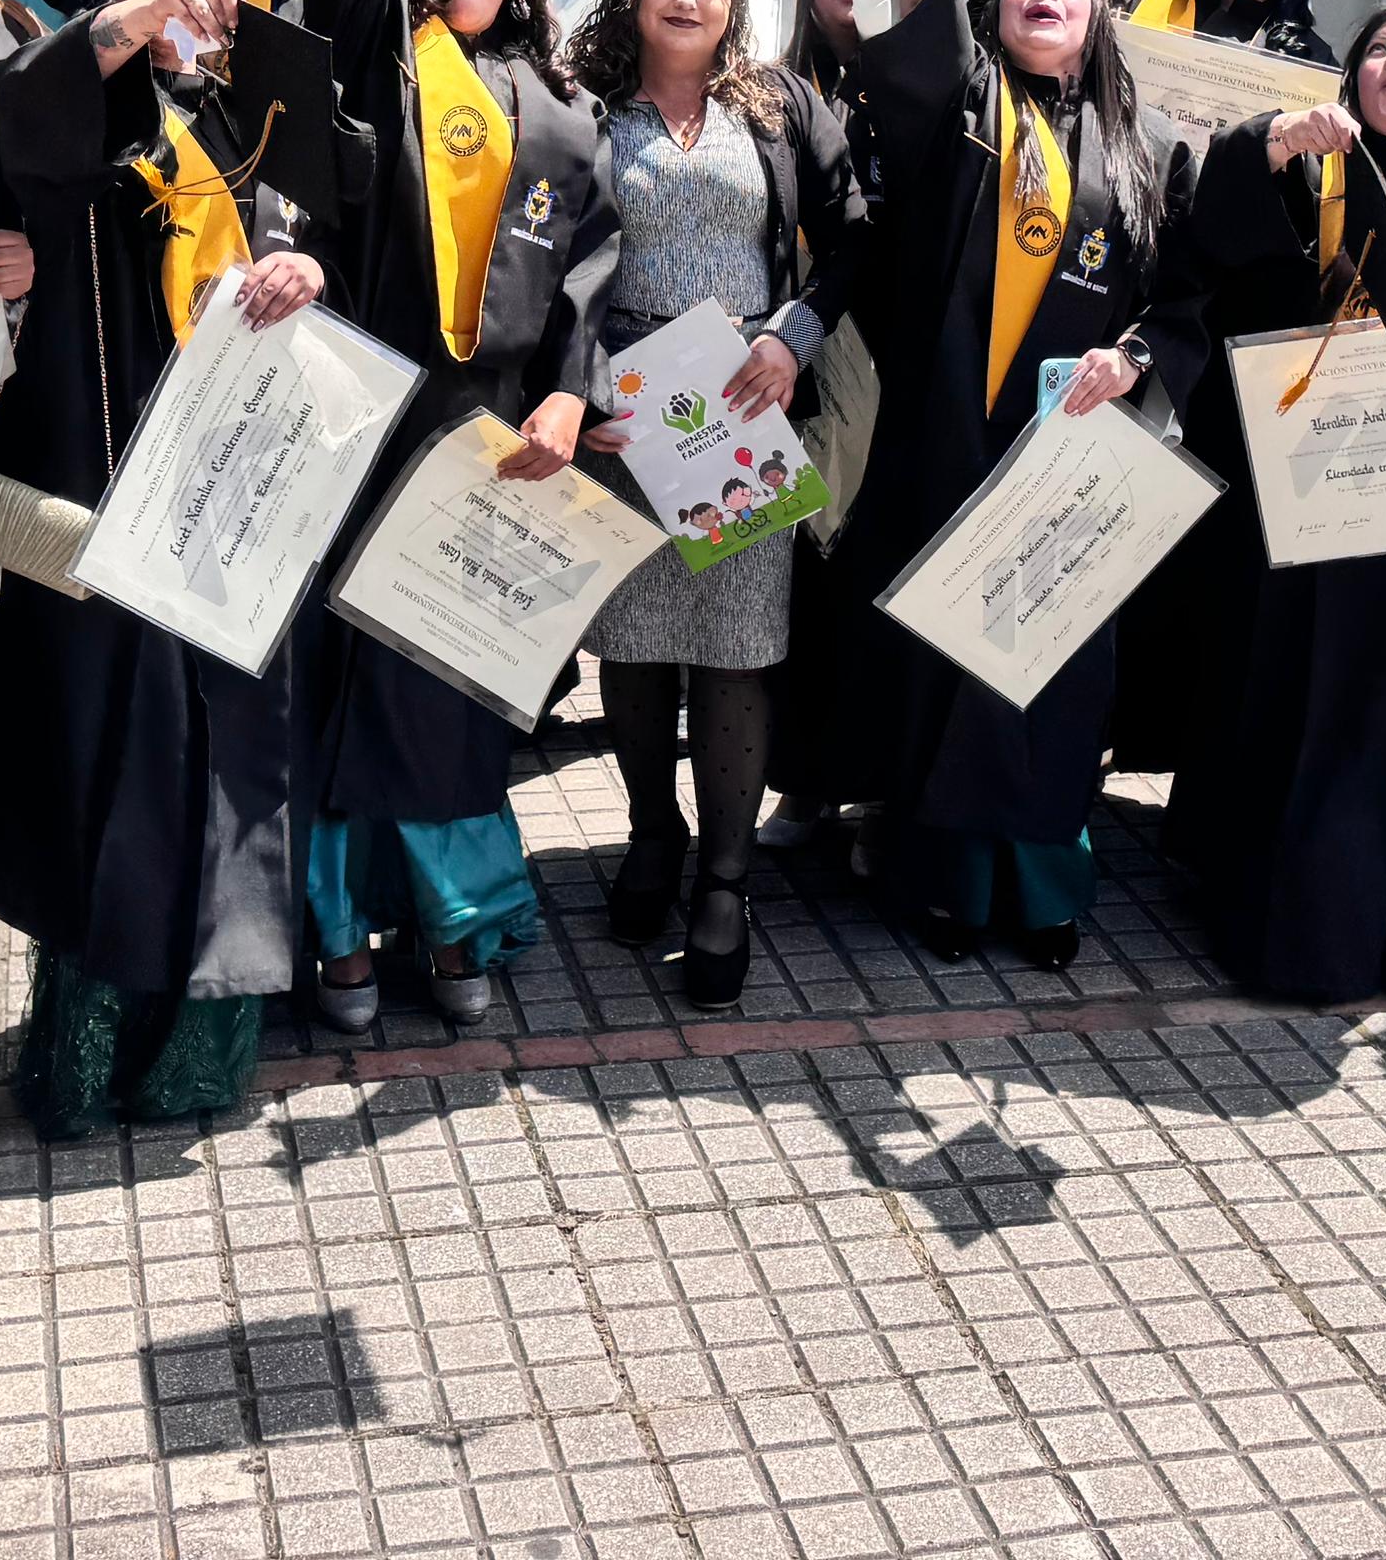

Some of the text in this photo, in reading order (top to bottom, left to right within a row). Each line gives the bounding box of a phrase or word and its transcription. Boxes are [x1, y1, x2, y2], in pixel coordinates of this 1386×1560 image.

[1174, 107, 1213, 129] Tatiana
[125, 471, 163, 536] FUNDACIÓN
[154, 396, 200, 475] UNIVERSITARIA
[194, 330, 237, 401] MONSERRATE
[181, 474, 218, 527] Natalia
[207, 414, 249, 476] Cárdenas
[240, 360, 280, 418] González
[676, 418, 726, 453] BIENESTAR
[681, 429, 732, 462] FAMILIAR
[217, 399, 315, 568] Licenciada en Educación Infantil
[1322, 462, 1376, 483] Licenciada
[461, 488, 499, 519] Infantil
[1052, 574, 1064, 586] en
[1059, 533, 1100, 577] Educación
[1095, 500, 1130, 537] Infantil
[977, 563, 1019, 608] Angélica
